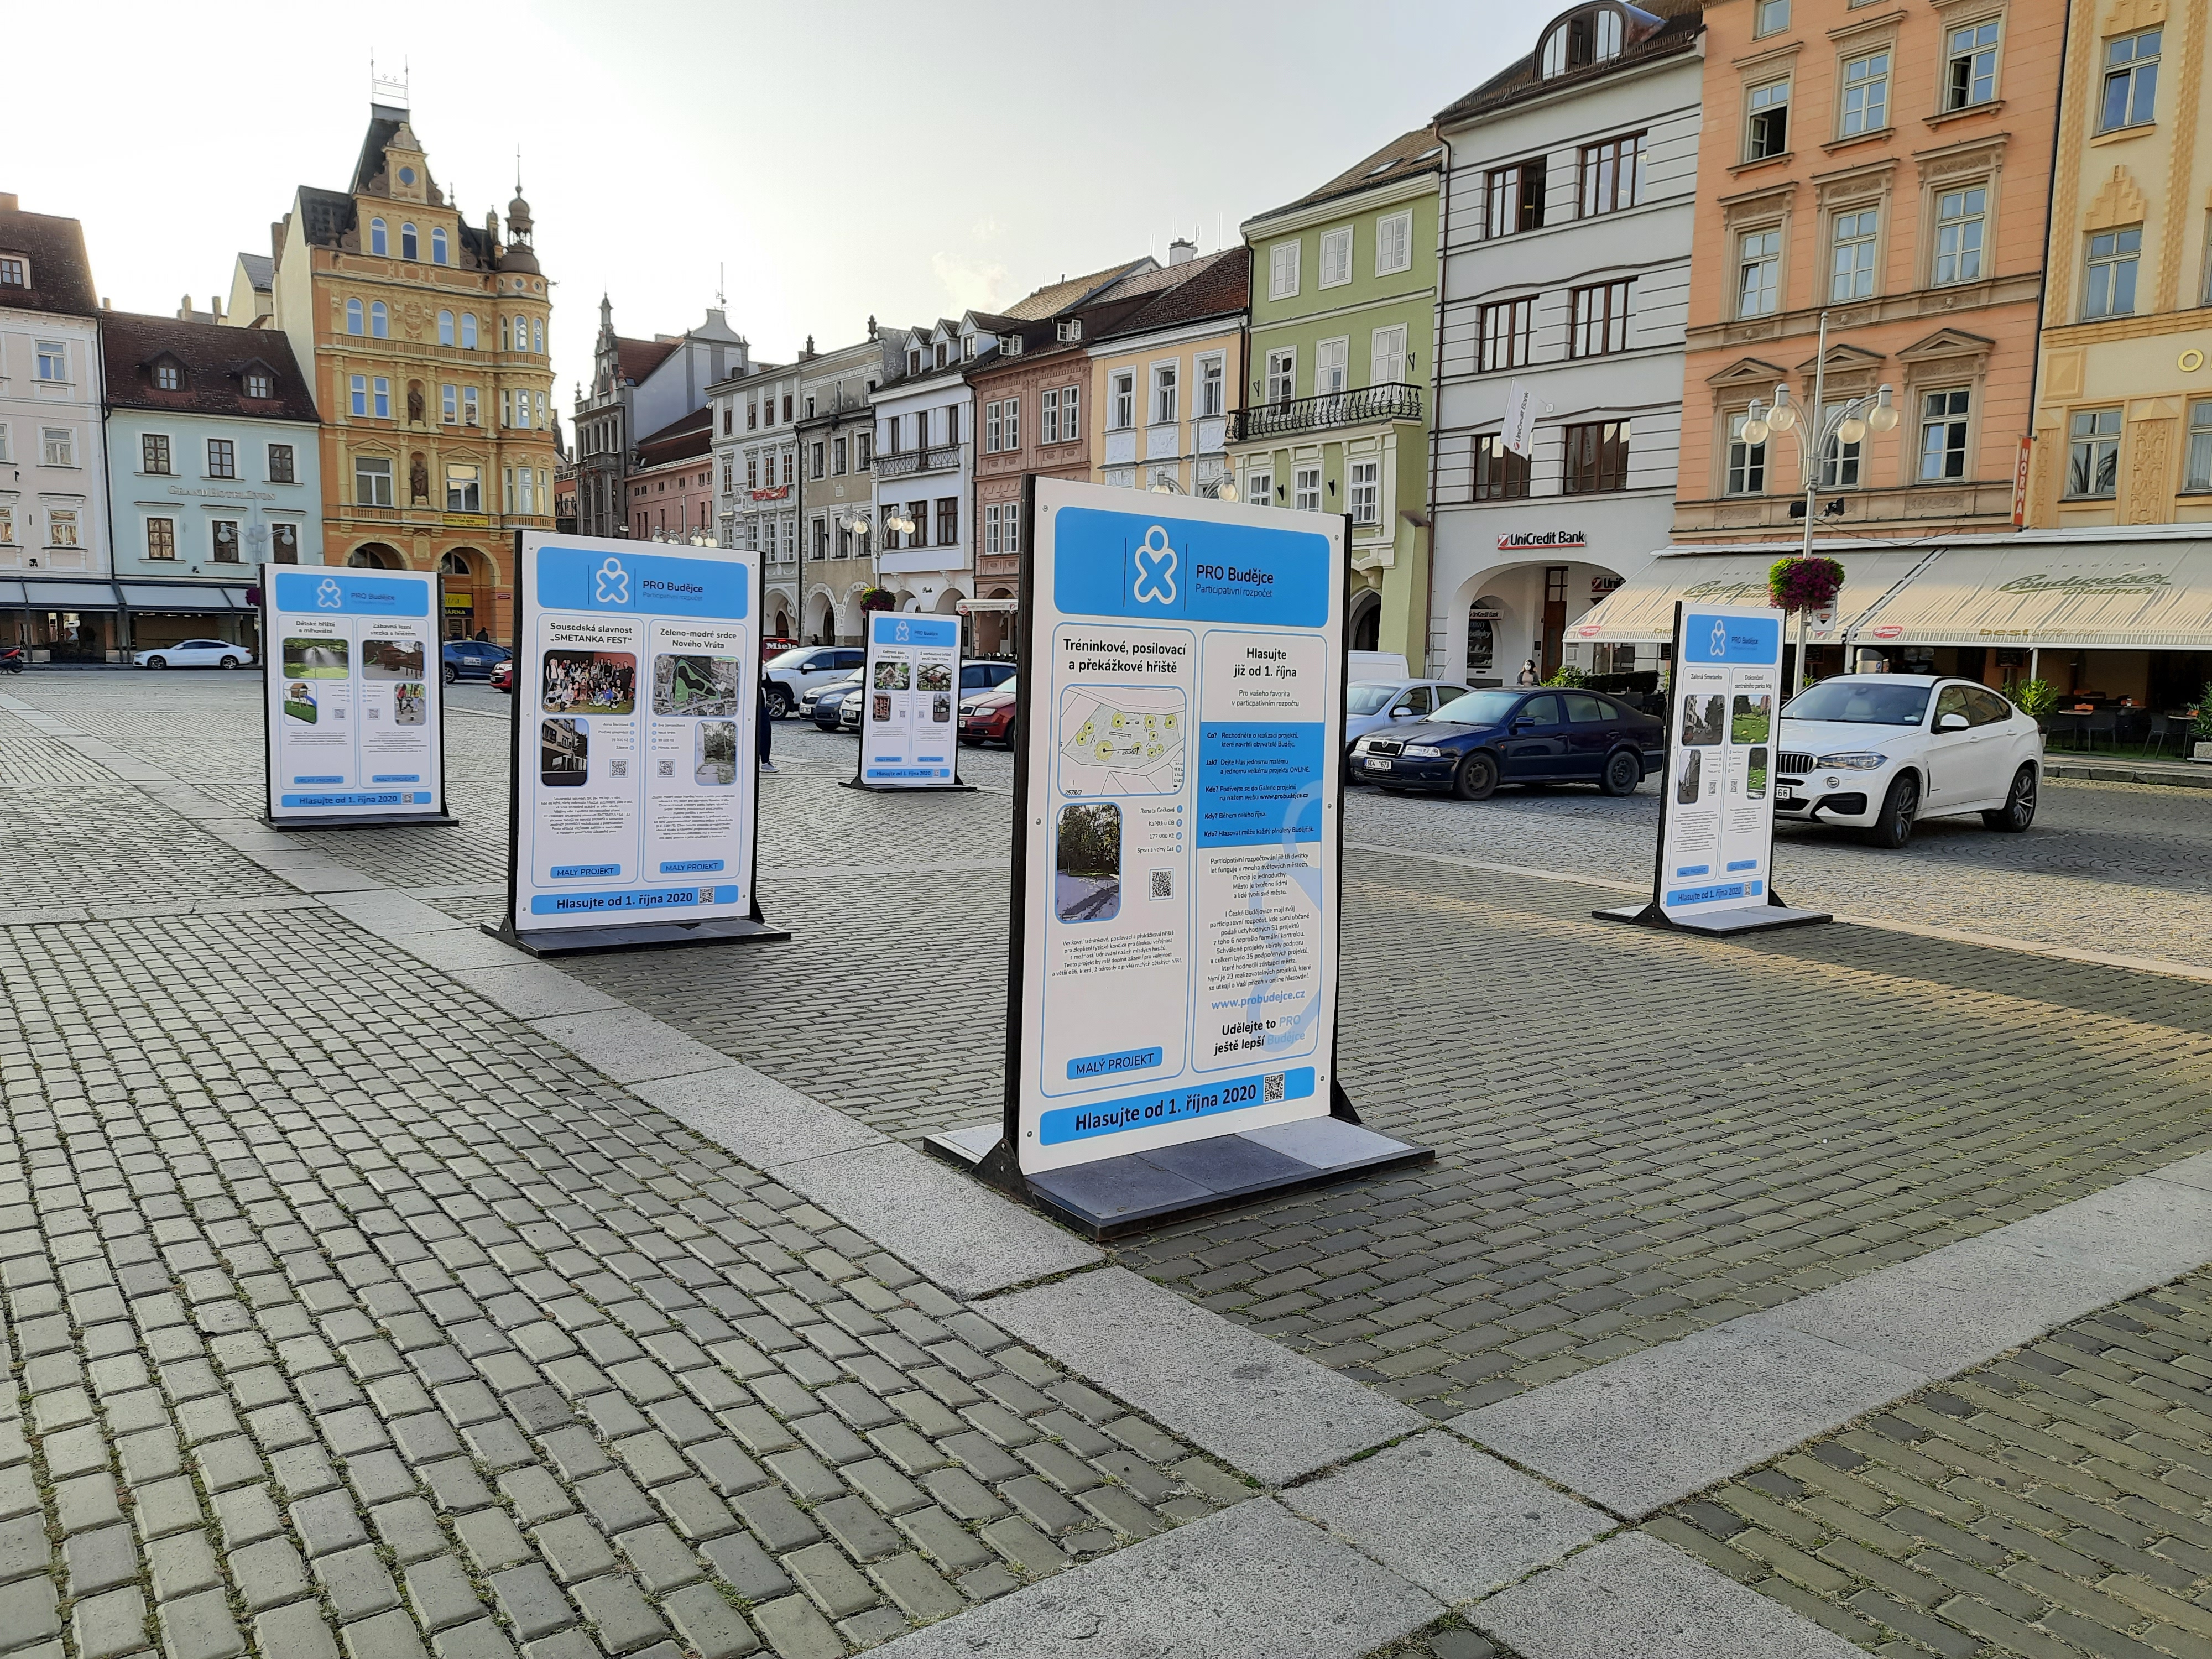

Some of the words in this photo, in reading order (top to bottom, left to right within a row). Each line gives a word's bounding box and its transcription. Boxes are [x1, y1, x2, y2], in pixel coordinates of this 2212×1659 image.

[2015, 448, 2030, 515] NORMA
[1510, 531, 1556, 546] UniCredit
[1558, 530, 1585, 544] Bank
[1196, 564, 1224, 581] PRO
[1228, 567, 1274, 586] Budějce
[1999, 573, 2172, 591] Budweiser
[643, 580, 664, 590] PRO
[667, 582, 703, 594] Budějce
[1196, 583, 1242, 597] Participativní
[1243, 586, 1273, 598] rozpočet
[550, 622, 596, 633] Sousedská
[598, 624, 633, 634] slavnost
[660, 628, 714, 638] Zeleno-modré
[716, 632, 737, 640] srdce
[672, 639, 702, 648] Nového
[703, 641, 724, 649] Vráta
[1063, 638, 1129, 655] Tréninkové,
[1132, 642, 1187, 656] posilovací
[1246, 648, 1287, 661] Hlasujte
[1068, 661, 1075, 670] a
[1079, 658, 1142, 672] překážkové
[1146, 661, 1177, 673] hřiště
[1233, 664, 1245, 678] již
[1249, 665, 1261, 676] od
[1265, 666, 1272, 676] 1.
[1276, 665, 1297, 679] října
[357, 796, 376, 804] října
[557, 867, 578, 876] MALÝ
[580, 867, 614, 875] PROJEKT
[666, 863, 685, 872] MALÝ
[686, 863, 718, 871] PROJEKT
[557, 898, 604, 910] Hlasujte
[607, 896, 623, 906] od
[625, 895, 635, 905] 1.
[638, 894, 663, 906] října
[666, 892, 692, 902] 2020
[1678, 893, 1700, 902] Hlasujte
[1729, 886, 1741, 895] 2020
[1221, 928, 1237, 937] podali
[1238, 926, 1270, 935] úctyhodných
[1279, 922, 1300, 931] projektů
[1244, 944, 1264, 952] projekty
[1265, 942, 1282, 950] sbíraly
[1212, 990, 1305, 1010] www.probudejce.cz
[1222, 1022, 1263, 1036] Udělejte
[1266, 1019, 1276, 1029] to
[1279, 1015, 1301, 1027] PRO
[1213, 1039, 1239, 1056] ještě
[1241, 1035, 1265, 1050] lepší
[1267, 1031, 1305, 1045] Budějce
[1076, 1058, 1105, 1076] MALÝ
[1108, 1052, 1154, 1071] PROJEKT
[1076, 1105, 1140, 1132] Hlasujte
[1144, 1102, 1162, 1118] od
[1168, 1099, 1182, 1115] 1.
[1186, 1094, 1218, 1114] října
[1222, 1084, 1256, 1105] 2020
